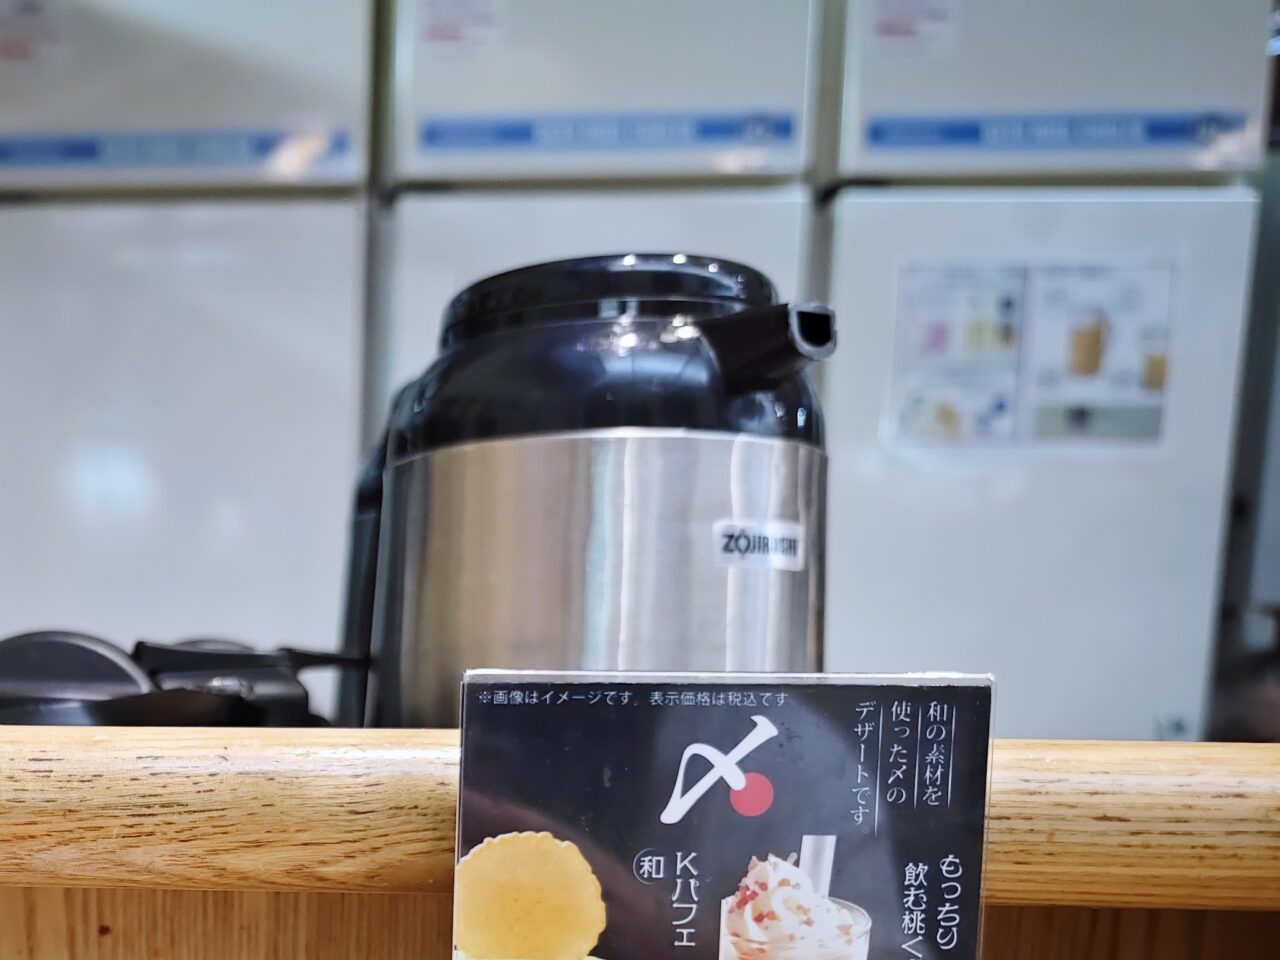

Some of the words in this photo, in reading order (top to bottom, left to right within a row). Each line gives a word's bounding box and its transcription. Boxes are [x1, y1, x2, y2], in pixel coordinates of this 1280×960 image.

[648, 690, 790, 707] 表示価格は税込です
[923, 700, 948, 806] 和の素材を
[671, 851, 700, 947] Kパフェ
[936, 854, 963, 950] もっちり
